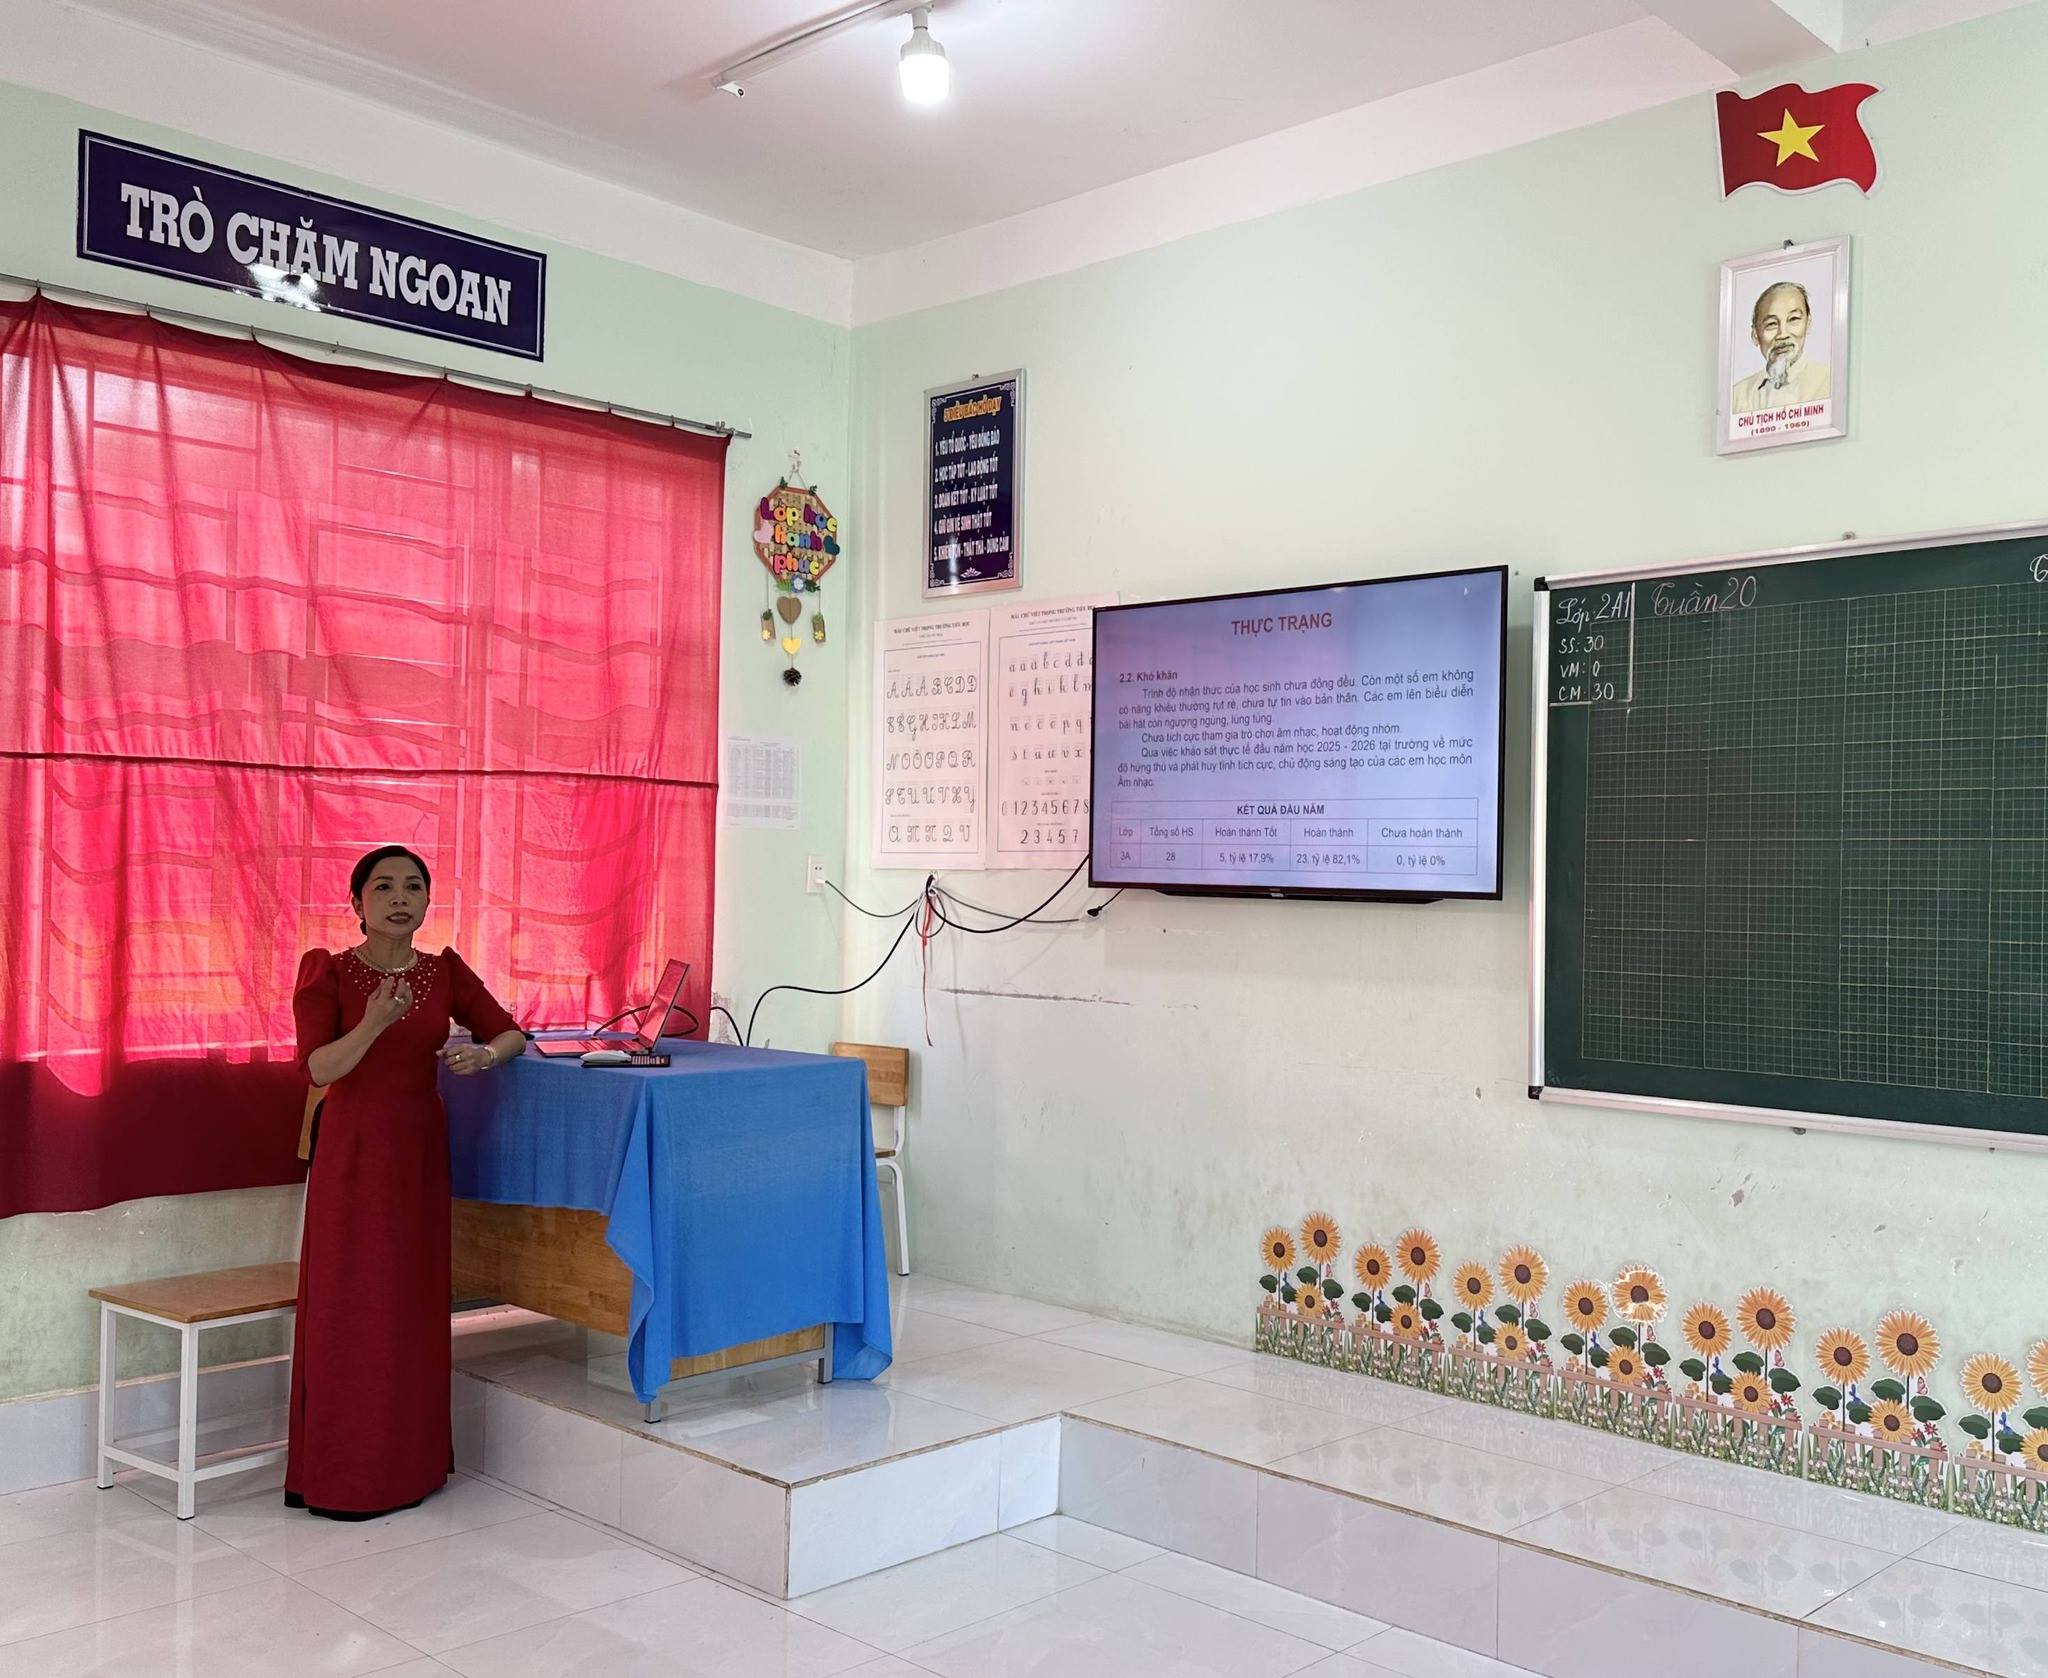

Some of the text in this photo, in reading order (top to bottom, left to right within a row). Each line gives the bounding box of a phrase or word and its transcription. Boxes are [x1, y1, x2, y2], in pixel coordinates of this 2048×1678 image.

[121, 183, 512, 326] TRÒ CHĂM NGOAN
[1738, 412, 1754, 427] CHỦ
[1756, 412, 1774, 426] TỊCH
[1776, 406, 1786, 421] HỒ
[1804, 404, 1824, 417] MINH
[760, 496, 799, 527] Lớp
[773, 551, 820, 576] phúc
[1652, 576, 1757, 616] Tuần 20
[1231, 612, 1333, 637] THỰC TRẠNG
[1584, 635, 1604, 653] 30
[1244, 682, 1260, 694] học
[1262, 680, 1280, 692] sinh
[1361, 674, 1381, 686] Còn
[1384, 672, 1404, 685] một
[1407, 669, 1418, 683] số
[1422, 672, 1438, 683] em
[1442, 668, 1474, 683] không
[1592, 682, 1614, 700] 30
[1242, 697, 1264, 708] chưa
[1280, 696, 1292, 707] tin
[1315, 692, 1332, 705] bản
[1364, 690, 1384, 702] Các
[1387, 692, 1402, 702] em
[1406, 688, 1421, 700] lên
[1426, 684, 1447, 700] biểu
[1451, 684, 1474, 698] diễn
[1142, 732, 1164, 744] Chưa
[1202, 729, 1223, 742] tham
[1225, 729, 1238, 742] gia
[1241, 728, 1252, 740] trò
[1322, 726, 1342, 736] hoạt
[1345, 724, 1369, 737] động
[1142, 747, 1158, 758] Qua
[1161, 746, 1178, 758] việc
[1254, 742, 1270, 754] đầu
[1297, 742, 1314, 754] học
[1317, 741, 1341, 752] 2025
[1351, 740, 1376, 751] 2026
[1379, 739, 1391, 750] tại
[1394, 738, 1429, 752] trường
[1433, 734, 1445, 749] về
[1449, 736, 1473, 748] mức
[1202, 759, 1216, 772] huy
[1278, 757, 1296, 769] chủ
[1298, 756, 1320, 770] động
[1324, 756, 1347, 770] sáng
[1350, 756, 1364, 768] tạo
[1368, 755, 1385, 768] của
[1388, 755, 1406, 766] các
[1408, 756, 1424, 766] em
[1428, 754, 1446, 767] học
[1450, 752, 1472, 766] môn
[1236, 803, 1325, 816] KẾT QUẢ ĐẦU NĂM
[1150, 826, 1169, 838] Tổng
[1182, 828, 1194, 837] HS
[1216, 828, 1236, 838] Hoàn
[1239, 827, 1262, 838] thành
[1264, 826, 1278, 838] Tốt
[1304, 827, 1327, 838] Hoàn
[1330, 827, 1354, 838] thành
[1381, 827, 1407, 838] Chưa
[1410, 827, 1433, 838] hoàn
[1436, 827, 1463, 838] thành
[1120, 850, 1132, 861] 3A
[1166, 852, 1176, 862] 28
[1249, 852, 1274, 864] 17,9%
[1296, 854, 1310, 865] 23,
[1332, 854, 1360, 865] 82,1%
[1430, 856, 1446, 866] 0%
